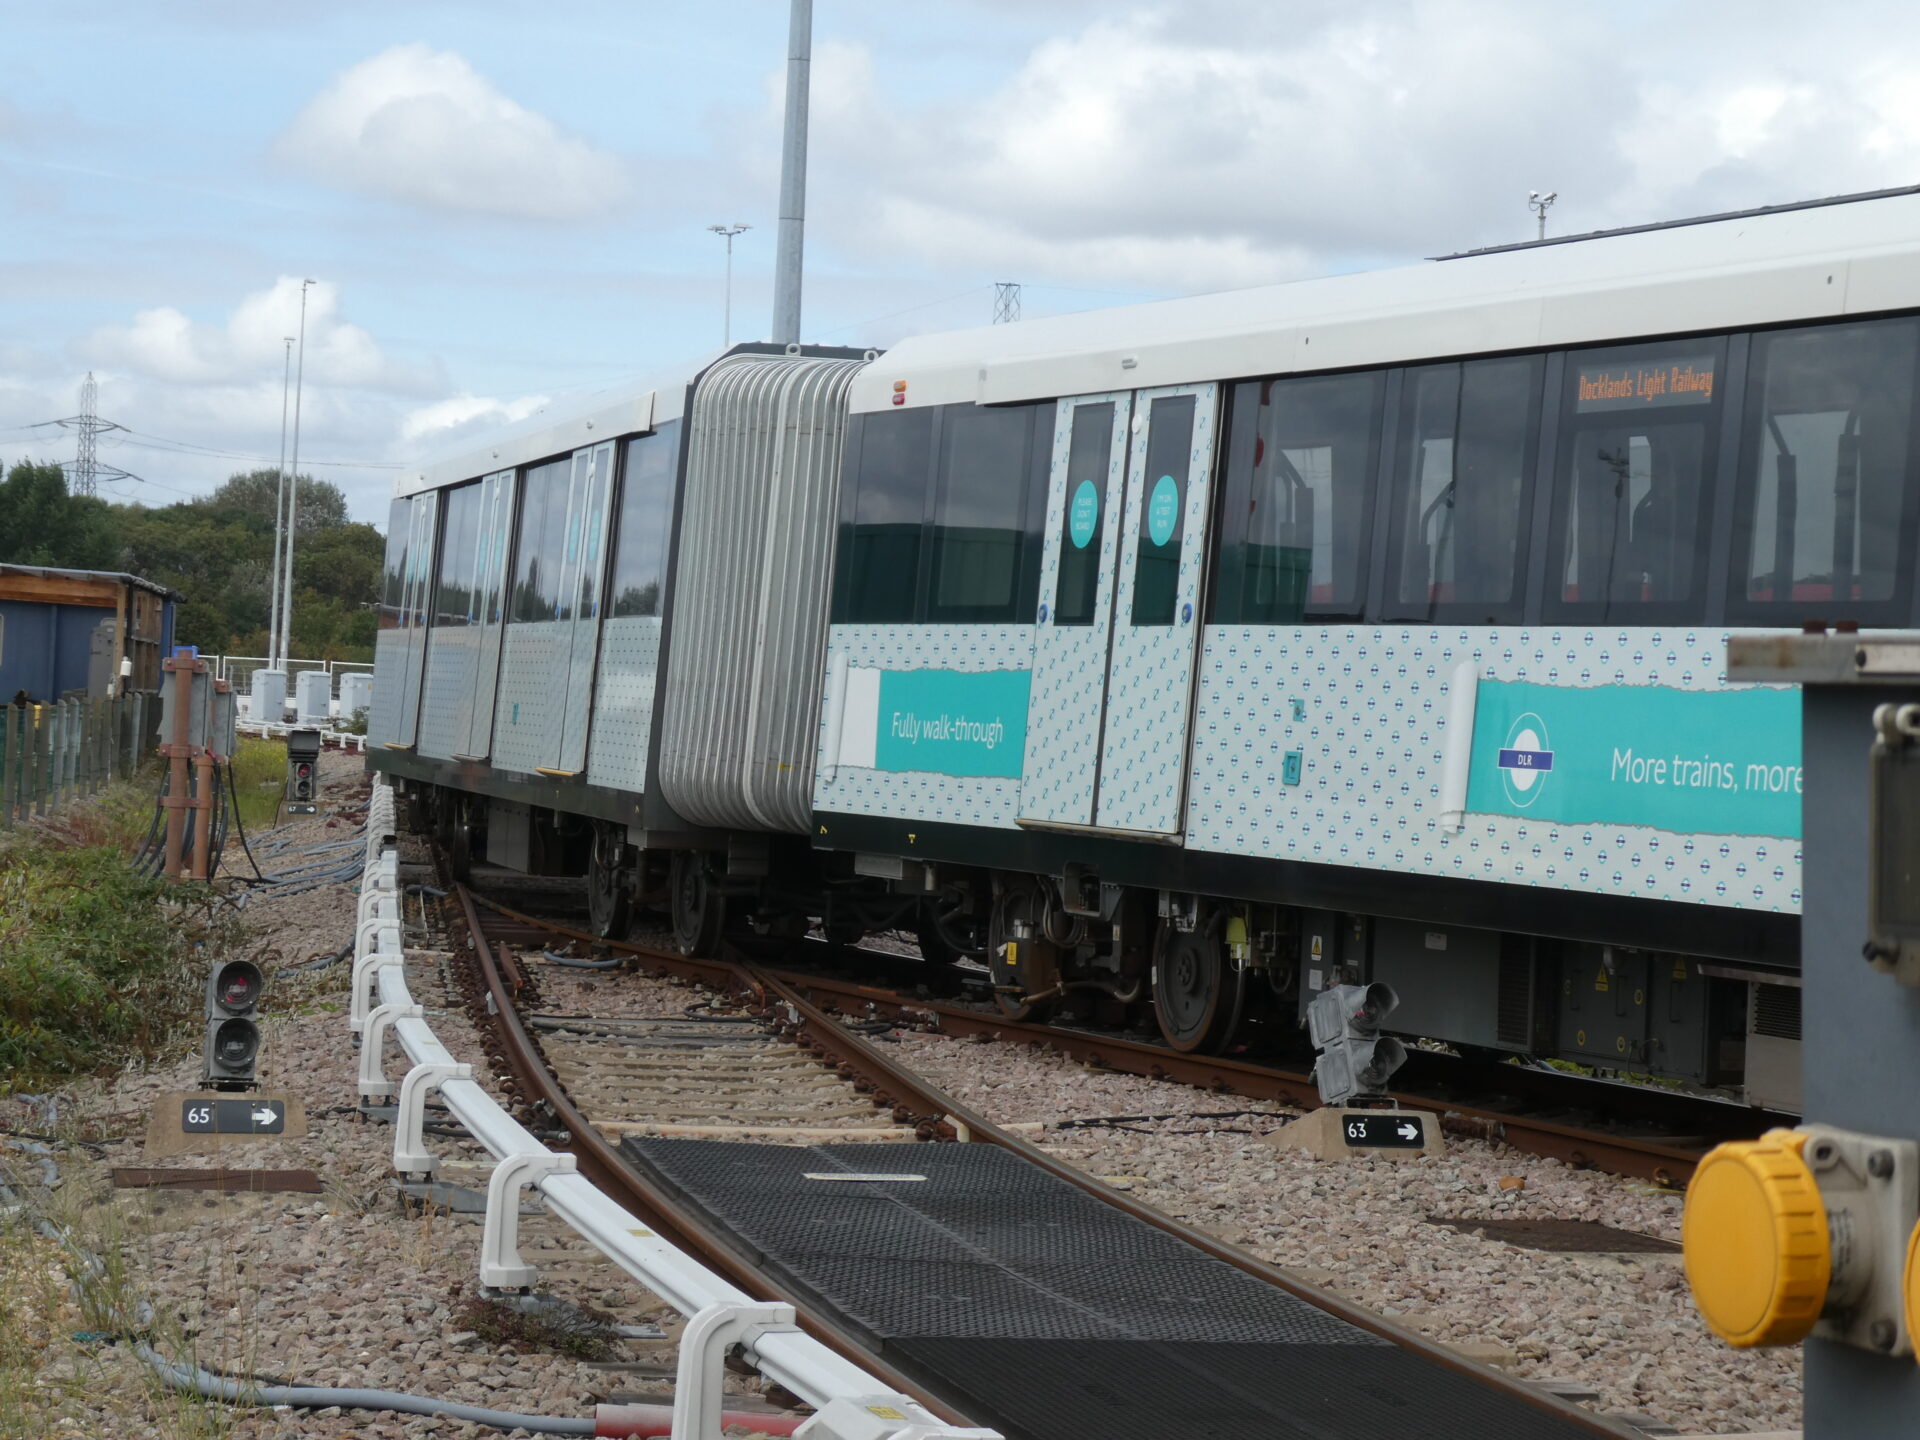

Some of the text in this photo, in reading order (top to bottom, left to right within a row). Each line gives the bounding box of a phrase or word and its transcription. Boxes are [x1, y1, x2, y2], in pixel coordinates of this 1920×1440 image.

[1578, 365, 1714, 402] Docklands Light Railway
[891, 711, 1003, 749] Fully walk-through
[1517, 753, 1533, 767] DLR
[1611, 747, 1803, 795] More trains, more
[187, 1107, 210, 1124] 65
[1347, 1122, 1367, 1138] 63
